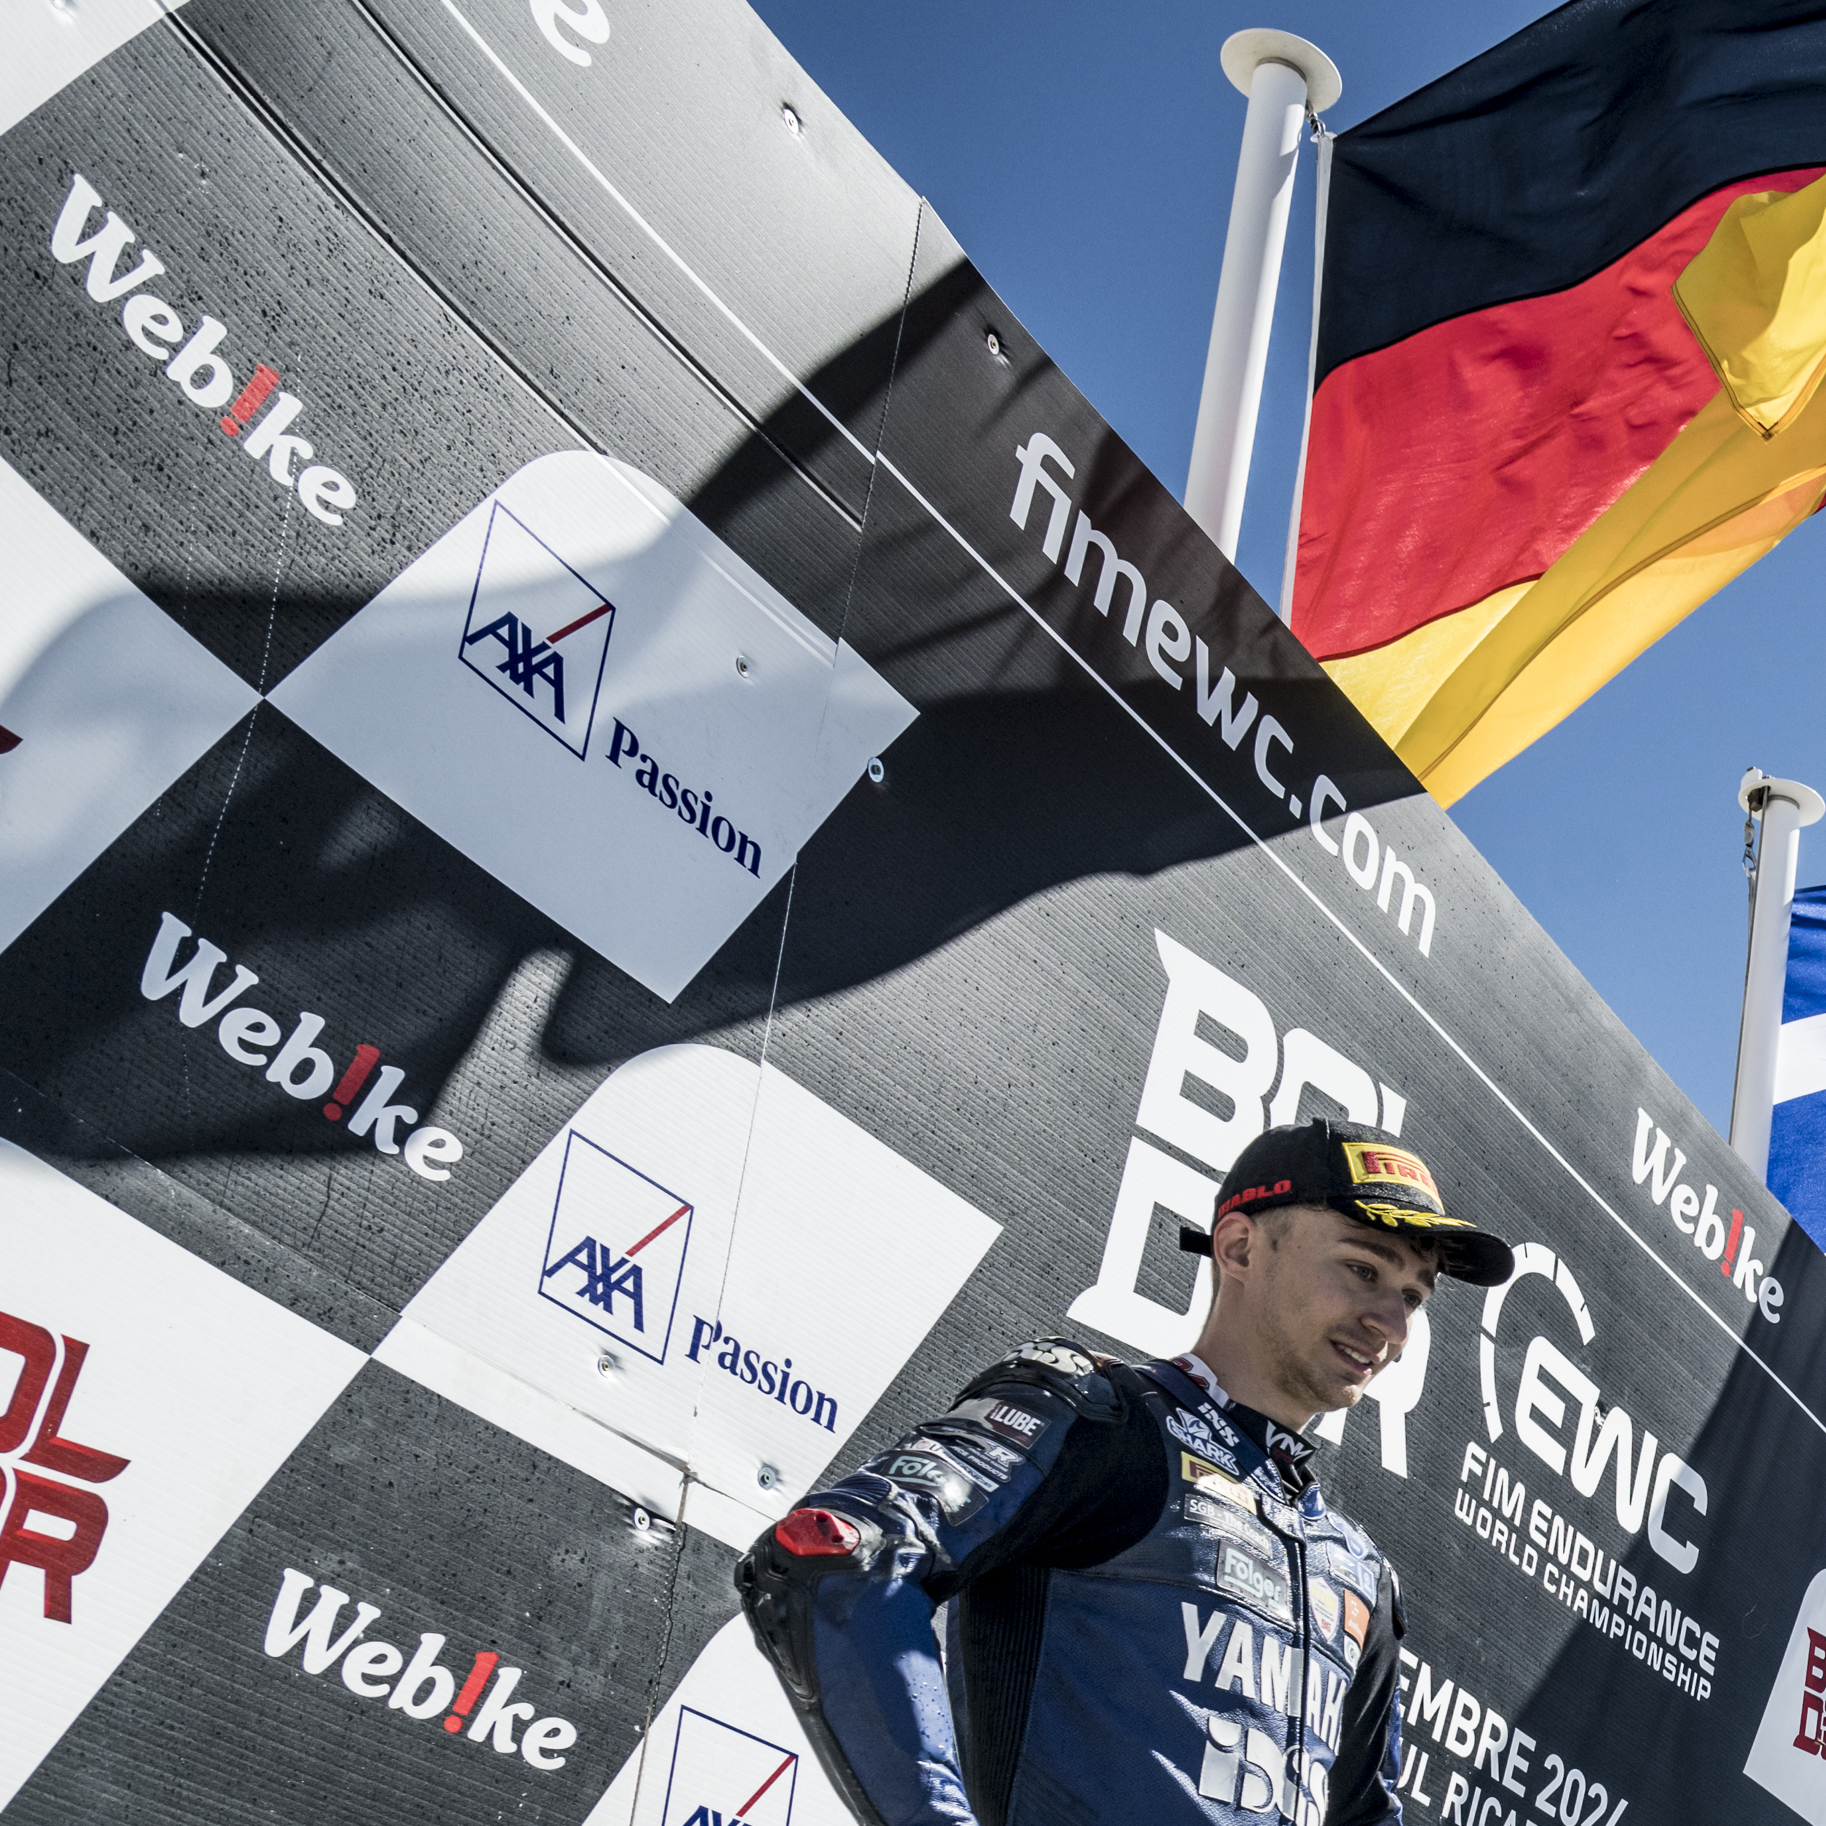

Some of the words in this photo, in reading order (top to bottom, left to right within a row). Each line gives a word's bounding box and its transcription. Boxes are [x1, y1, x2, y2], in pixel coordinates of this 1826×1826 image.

[466, 612, 566, 724] AXA
[1009, 431, 1438, 958] fimewc.com
[605, 716, 762, 879] Passion
[544, 1235, 646, 1334] AXA
[684, 1315, 839, 1434] Passion
[990, 1404, 1041, 1437] LUBE
[1515, 1335, 1709, 1574] EWC
[1454, 1488, 1538, 1577] WORLD
[1542, 1561, 1712, 1702] CHAMPIONSHIP
[1460, 1441, 1528, 1529] FIM
[1529, 1499, 1721, 1677] ENDURANCE
